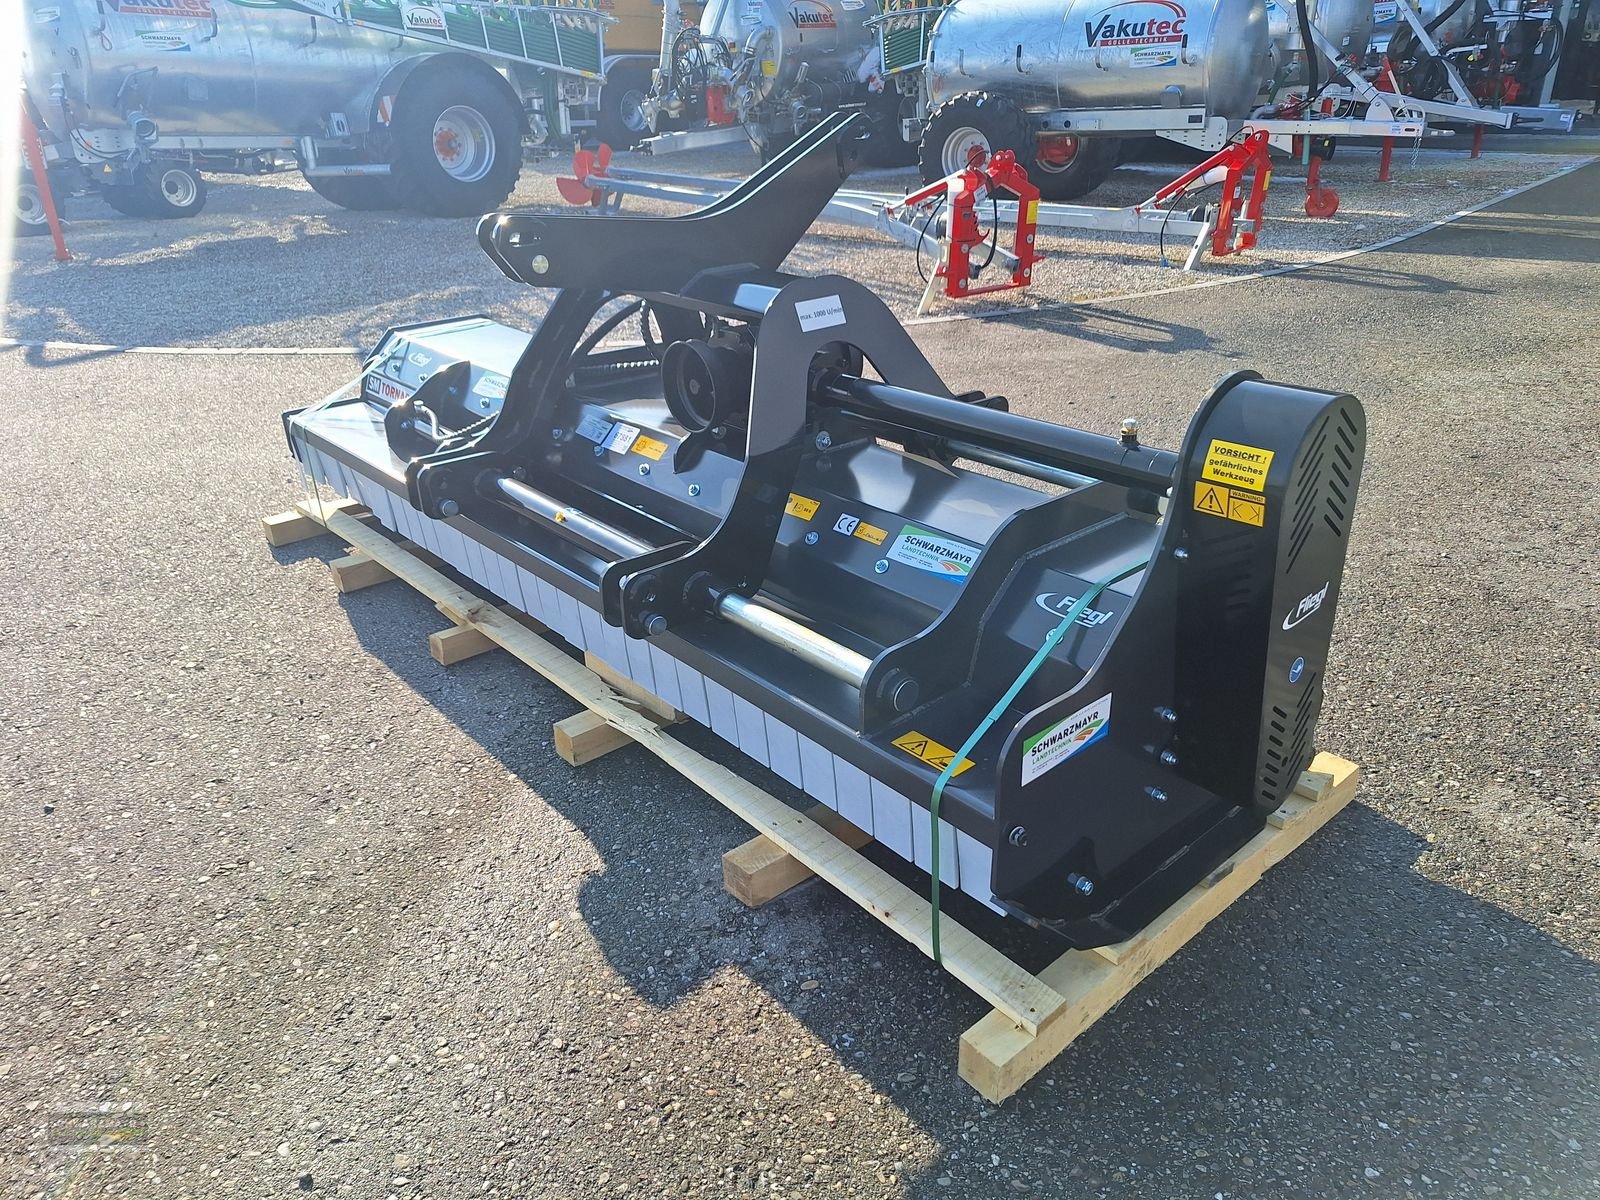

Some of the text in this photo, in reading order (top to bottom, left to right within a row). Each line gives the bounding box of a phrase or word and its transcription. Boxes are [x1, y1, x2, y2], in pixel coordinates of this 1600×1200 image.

[406, 12, 443, 24] Vakutec
[788, 7, 834, 28] Vakutec
[1085, 14, 1185, 47] Vakutec
[368, 376, 380, 392] SM
[1214, 446, 1261, 462] VORSICHT
[1209, 459, 1264, 476] gefährliches
[1212, 468, 1255, 485] Werkzeug
[901, 544, 940, 563] LANDTECHNIK
[904, 536, 972, 564] SCHWARZMAYR
[1296, 581, 1329, 618] Fliegl
[1031, 711, 1099, 757] SCHWARZMAYR
[1032, 738, 1072, 765] LANDTECHNIK
